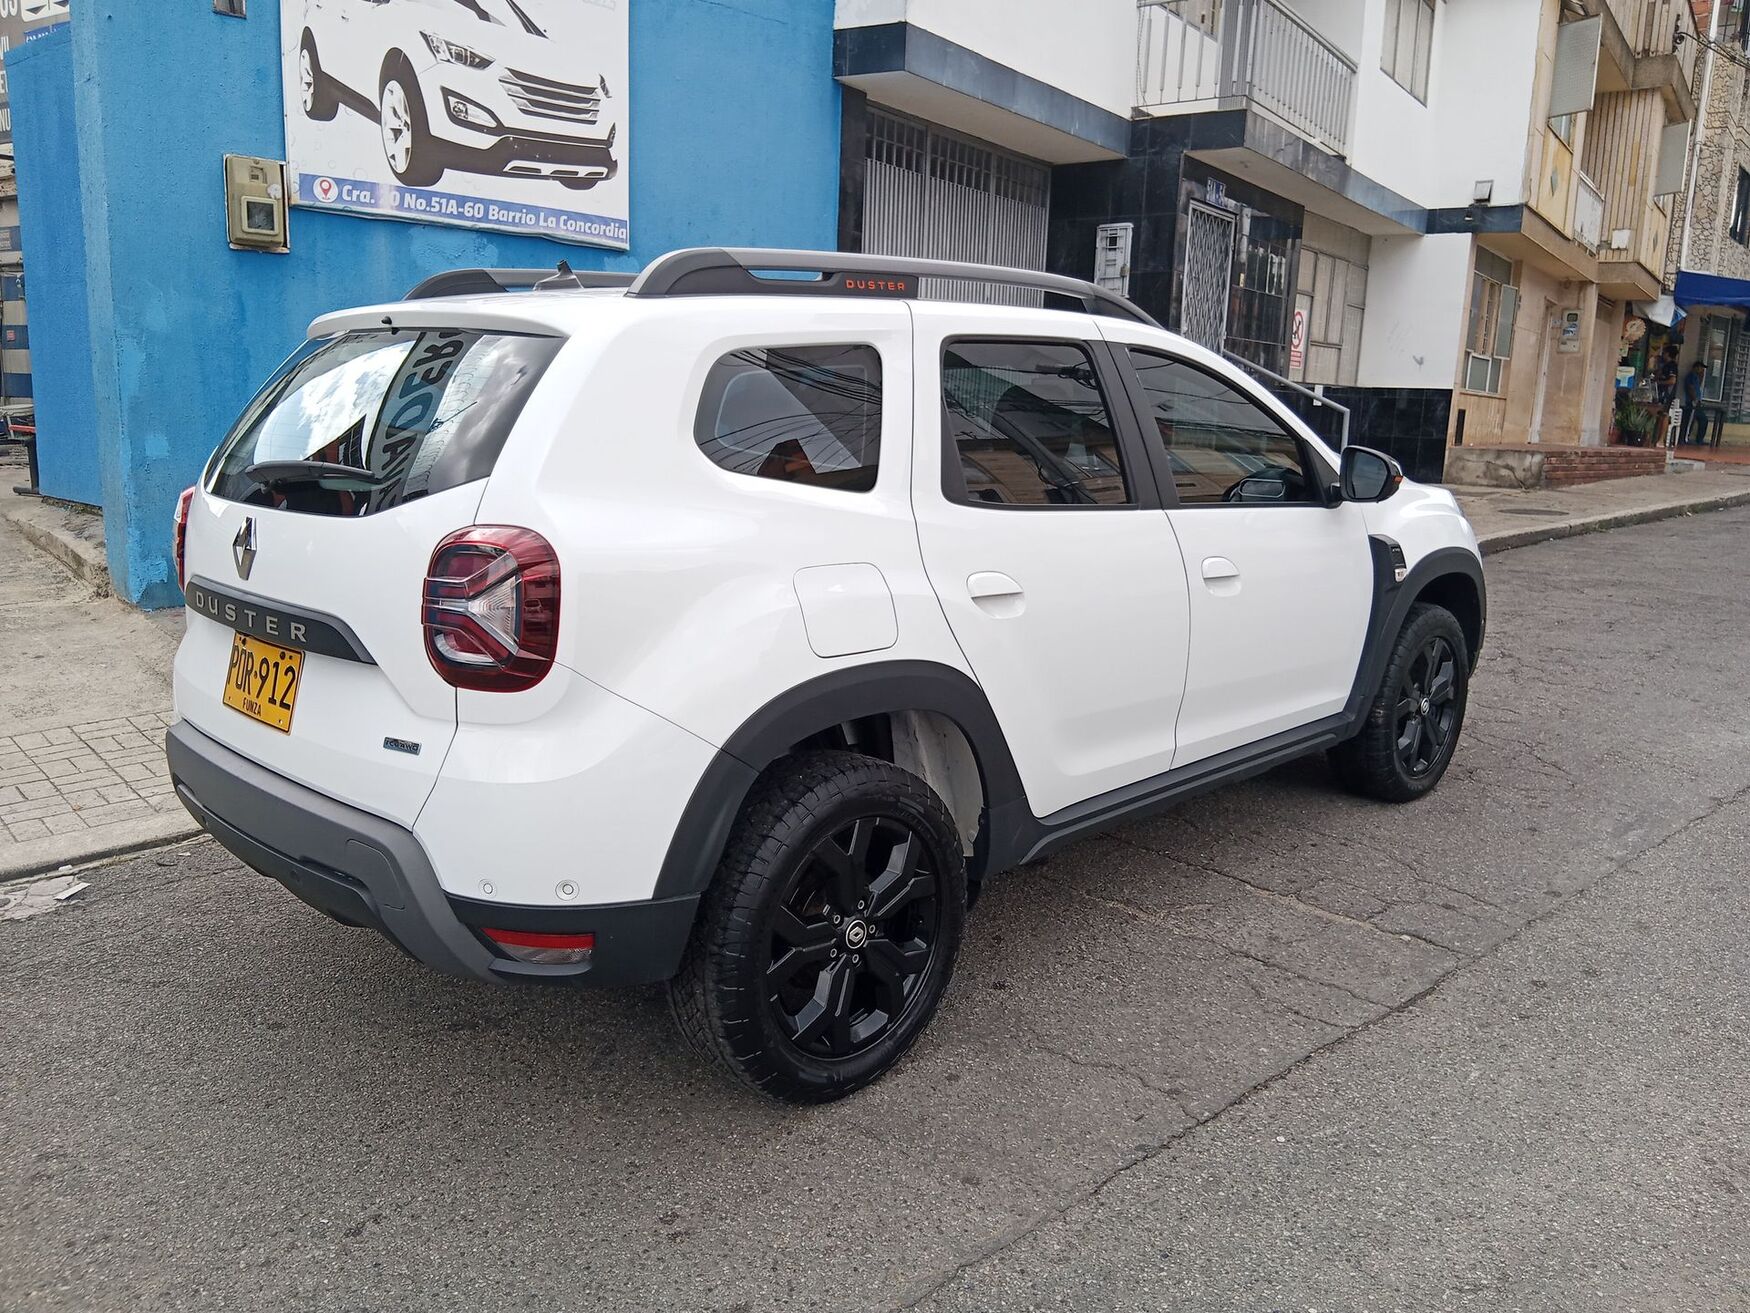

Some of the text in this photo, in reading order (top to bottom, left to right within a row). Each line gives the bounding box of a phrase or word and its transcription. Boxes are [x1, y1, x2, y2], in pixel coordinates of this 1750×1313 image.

[342, 185, 375, 203] Cra.
[404, 192, 484, 218] No.51A-60
[488, 205, 536, 225] Barrio
[539, 212, 557, 228] La
[559, 215, 627, 240] Concordia
[845, 279, 905, 291] DUSTER
[195, 590, 308, 643] DUSTER
[243, 697, 262, 717] FUNZA
